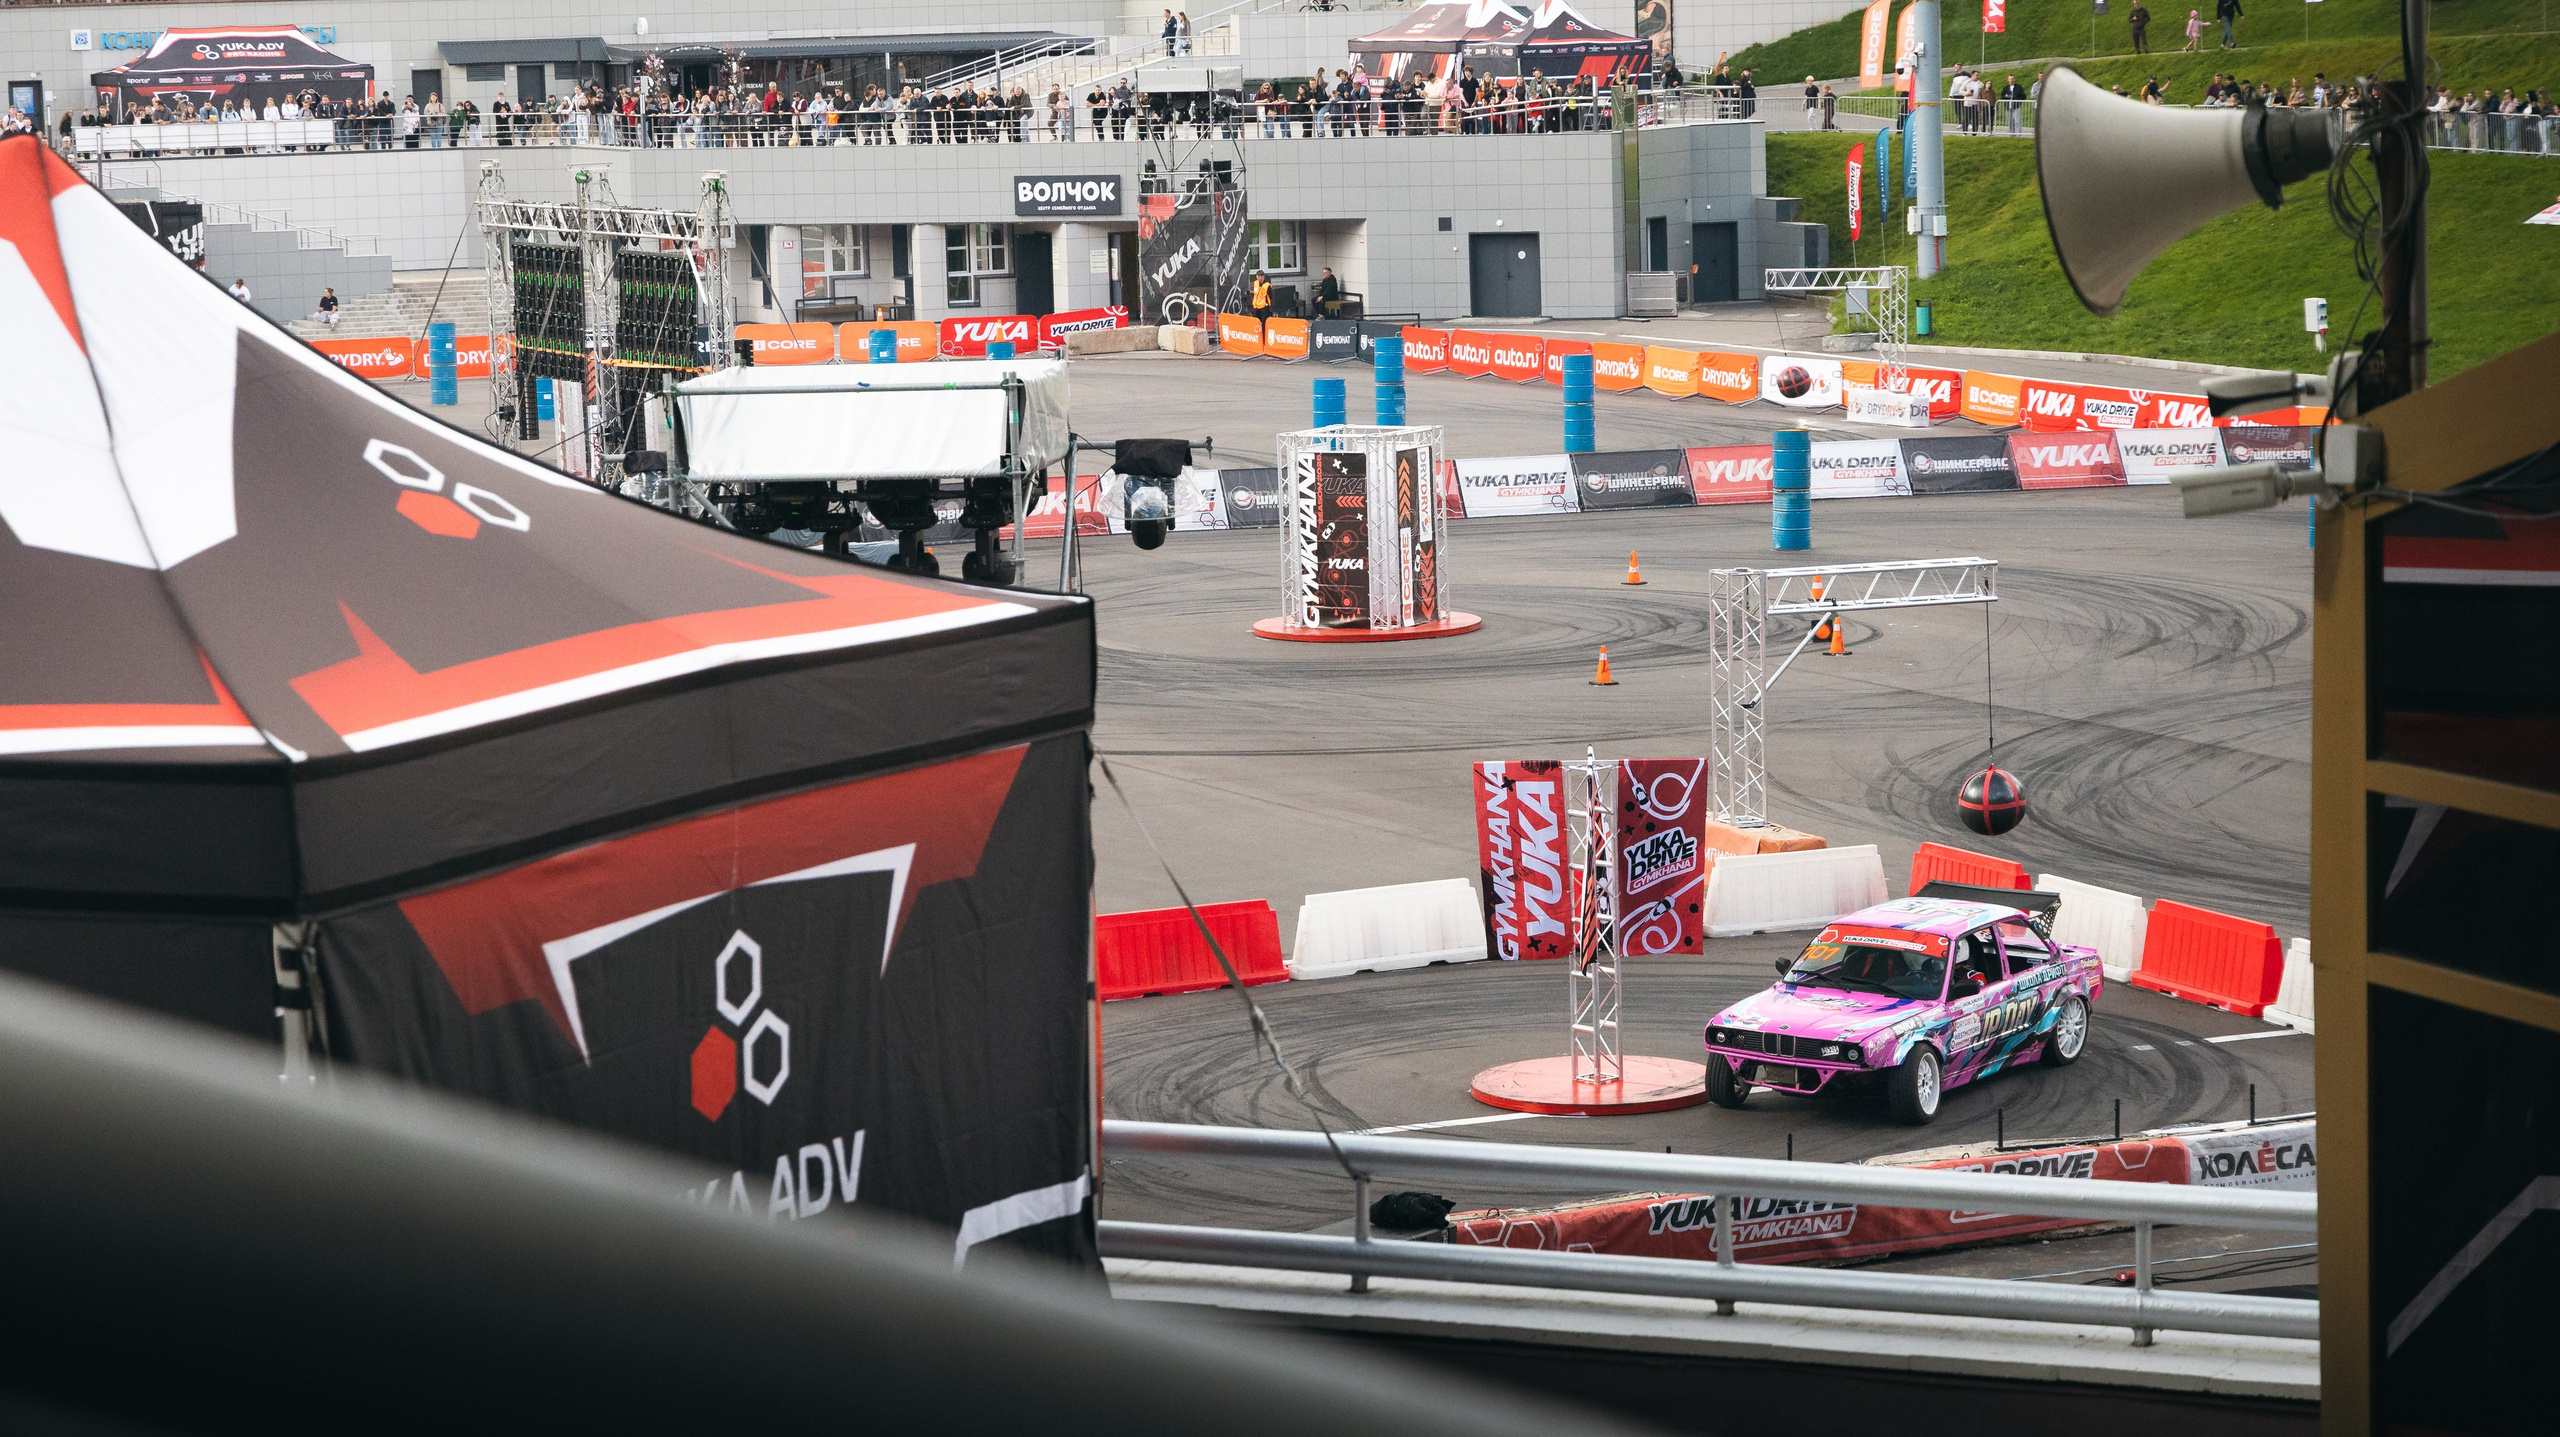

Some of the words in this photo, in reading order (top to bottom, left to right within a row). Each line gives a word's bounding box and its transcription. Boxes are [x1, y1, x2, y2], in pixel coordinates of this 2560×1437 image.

[216, 42, 256, 51] YUKA
[257, 42, 285, 50] ADV
[1018, 181, 1116, 203] ВОЛЧОК
[1152, 237, 1201, 288] YUKA
[953, 321, 1029, 342] YUKA
[1081, 318, 1116, 332] DRIVE
[1229, 329, 1259, 344] ЧЕМПИОНАТ
[1274, 332, 1304, 346] ЧЕМПИОНАТ
[1322, 335, 1351, 345] ЧЕМПИОНАТ
[1404, 341, 1445, 361] auto.ru
[1452, 342, 1490, 364] auto.ru
[1494, 348, 1539, 368] auto.ru
[2026, 388, 2076, 417] YUKA
[2086, 402, 2108, 414] YUKA
[2109, 404, 2137, 416] DRIVE
[2029, 443, 2111, 468] YUKA
[2124, 445, 2167, 457] YUKA
[2168, 443, 2218, 456] DRIVE
[1846, 456, 1897, 469] DRIVE
[1933, 457, 2009, 470] ШИНСЕРВИС
[2156, 456, 2215, 465] GYMKHANA
[1419, 451, 1429, 517] DRYDRY
[1464, 475, 1509, 488] YUKA
[1512, 471, 1568, 487] DRIVE
[1608, 475, 1686, 489] ШИНСЕРВИС
[1835, 469, 1894, 479] GYMKHANA
[1500, 486, 1563, 497] GYMKHANA
[1297, 453, 1320, 628] GYMKHANA
[1328, 558, 1364, 570] YUKA
[1626, 830, 1684, 863] YUKA
[1483, 761, 1520, 961] GYMKHANA
[1516, 781, 1566, 937] YUKA
[1631, 841, 1695, 880] DRIVE
[1632, 860, 1692, 888] GYMKHANA
[1803, 945, 1841, 961] 101
[2019, 971, 2043, 991] ШКОЛА
[768, 1128, 866, 1222] ADV
